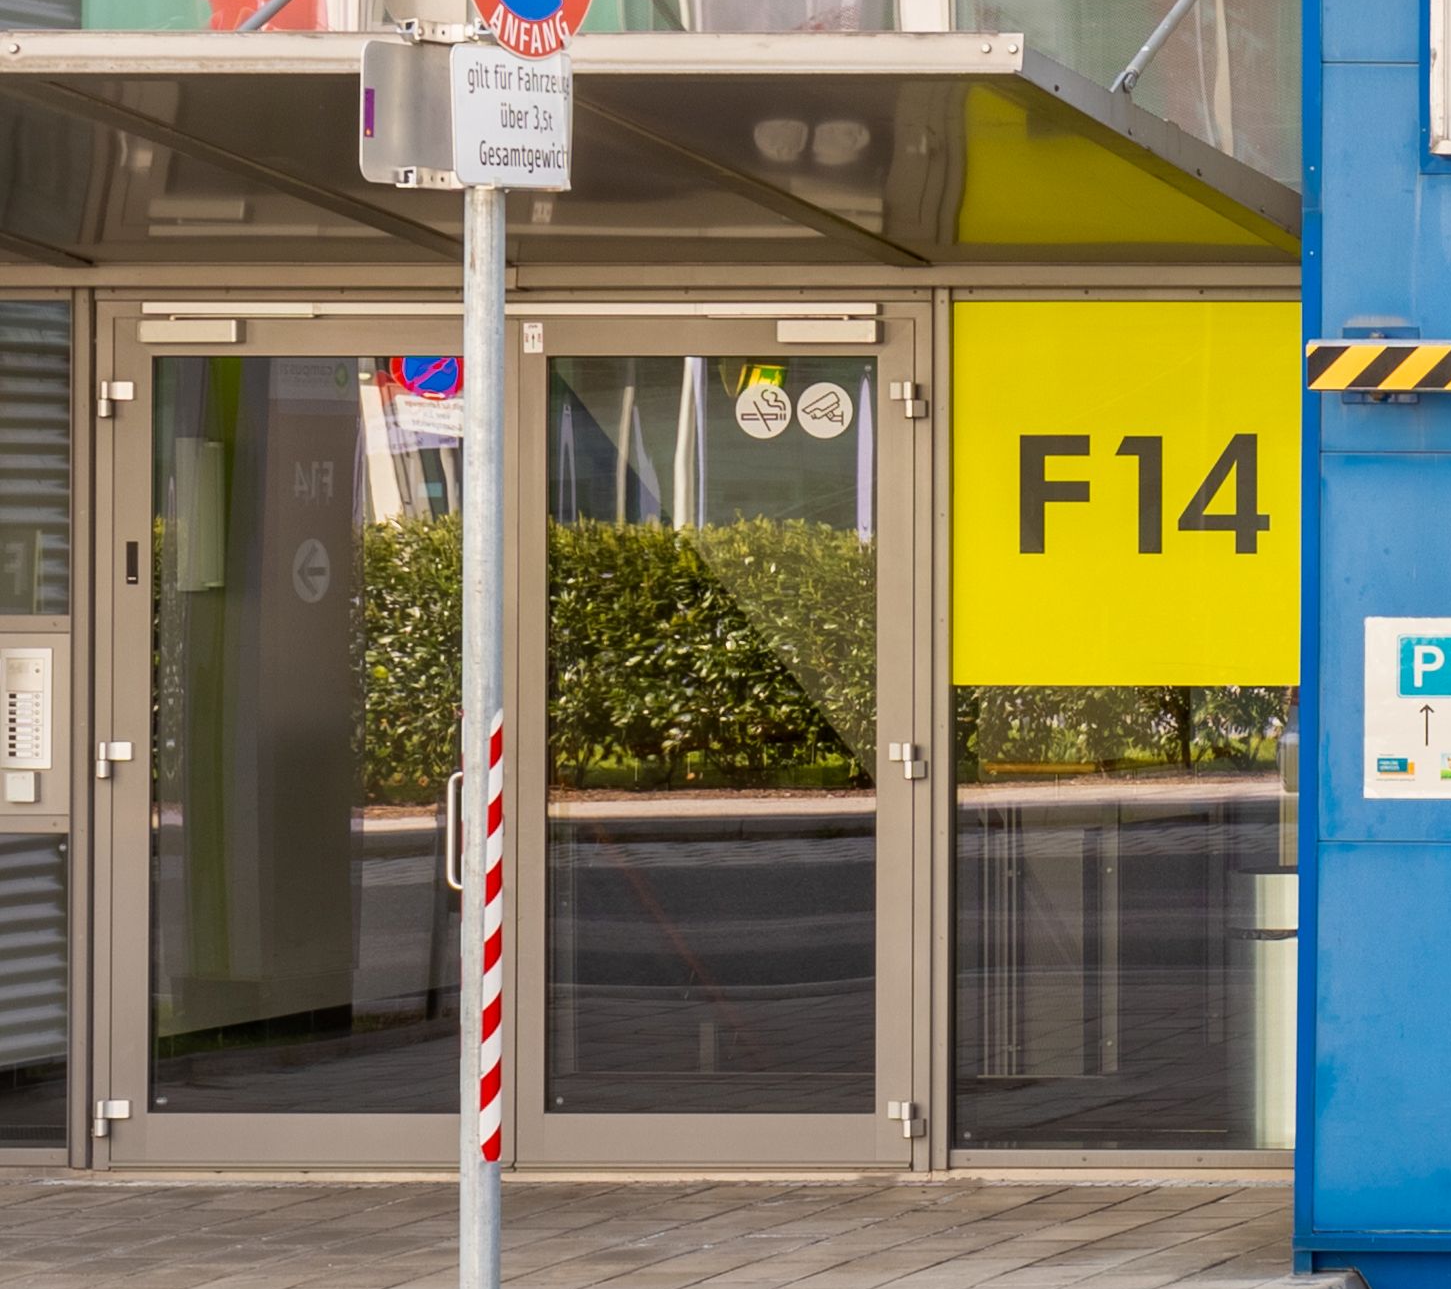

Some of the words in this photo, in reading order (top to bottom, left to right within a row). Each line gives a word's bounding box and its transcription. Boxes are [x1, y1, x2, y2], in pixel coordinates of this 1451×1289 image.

[489, 3, 570, 54] ANFANG
[467, 62, 490, 94] gilt
[494, 64, 513, 90] für
[500, 102, 529, 129] über
[532, 105, 553, 133] 3,5t
[1019, 433, 1270, 554] F14
[1413, 645, 1446, 688] P
